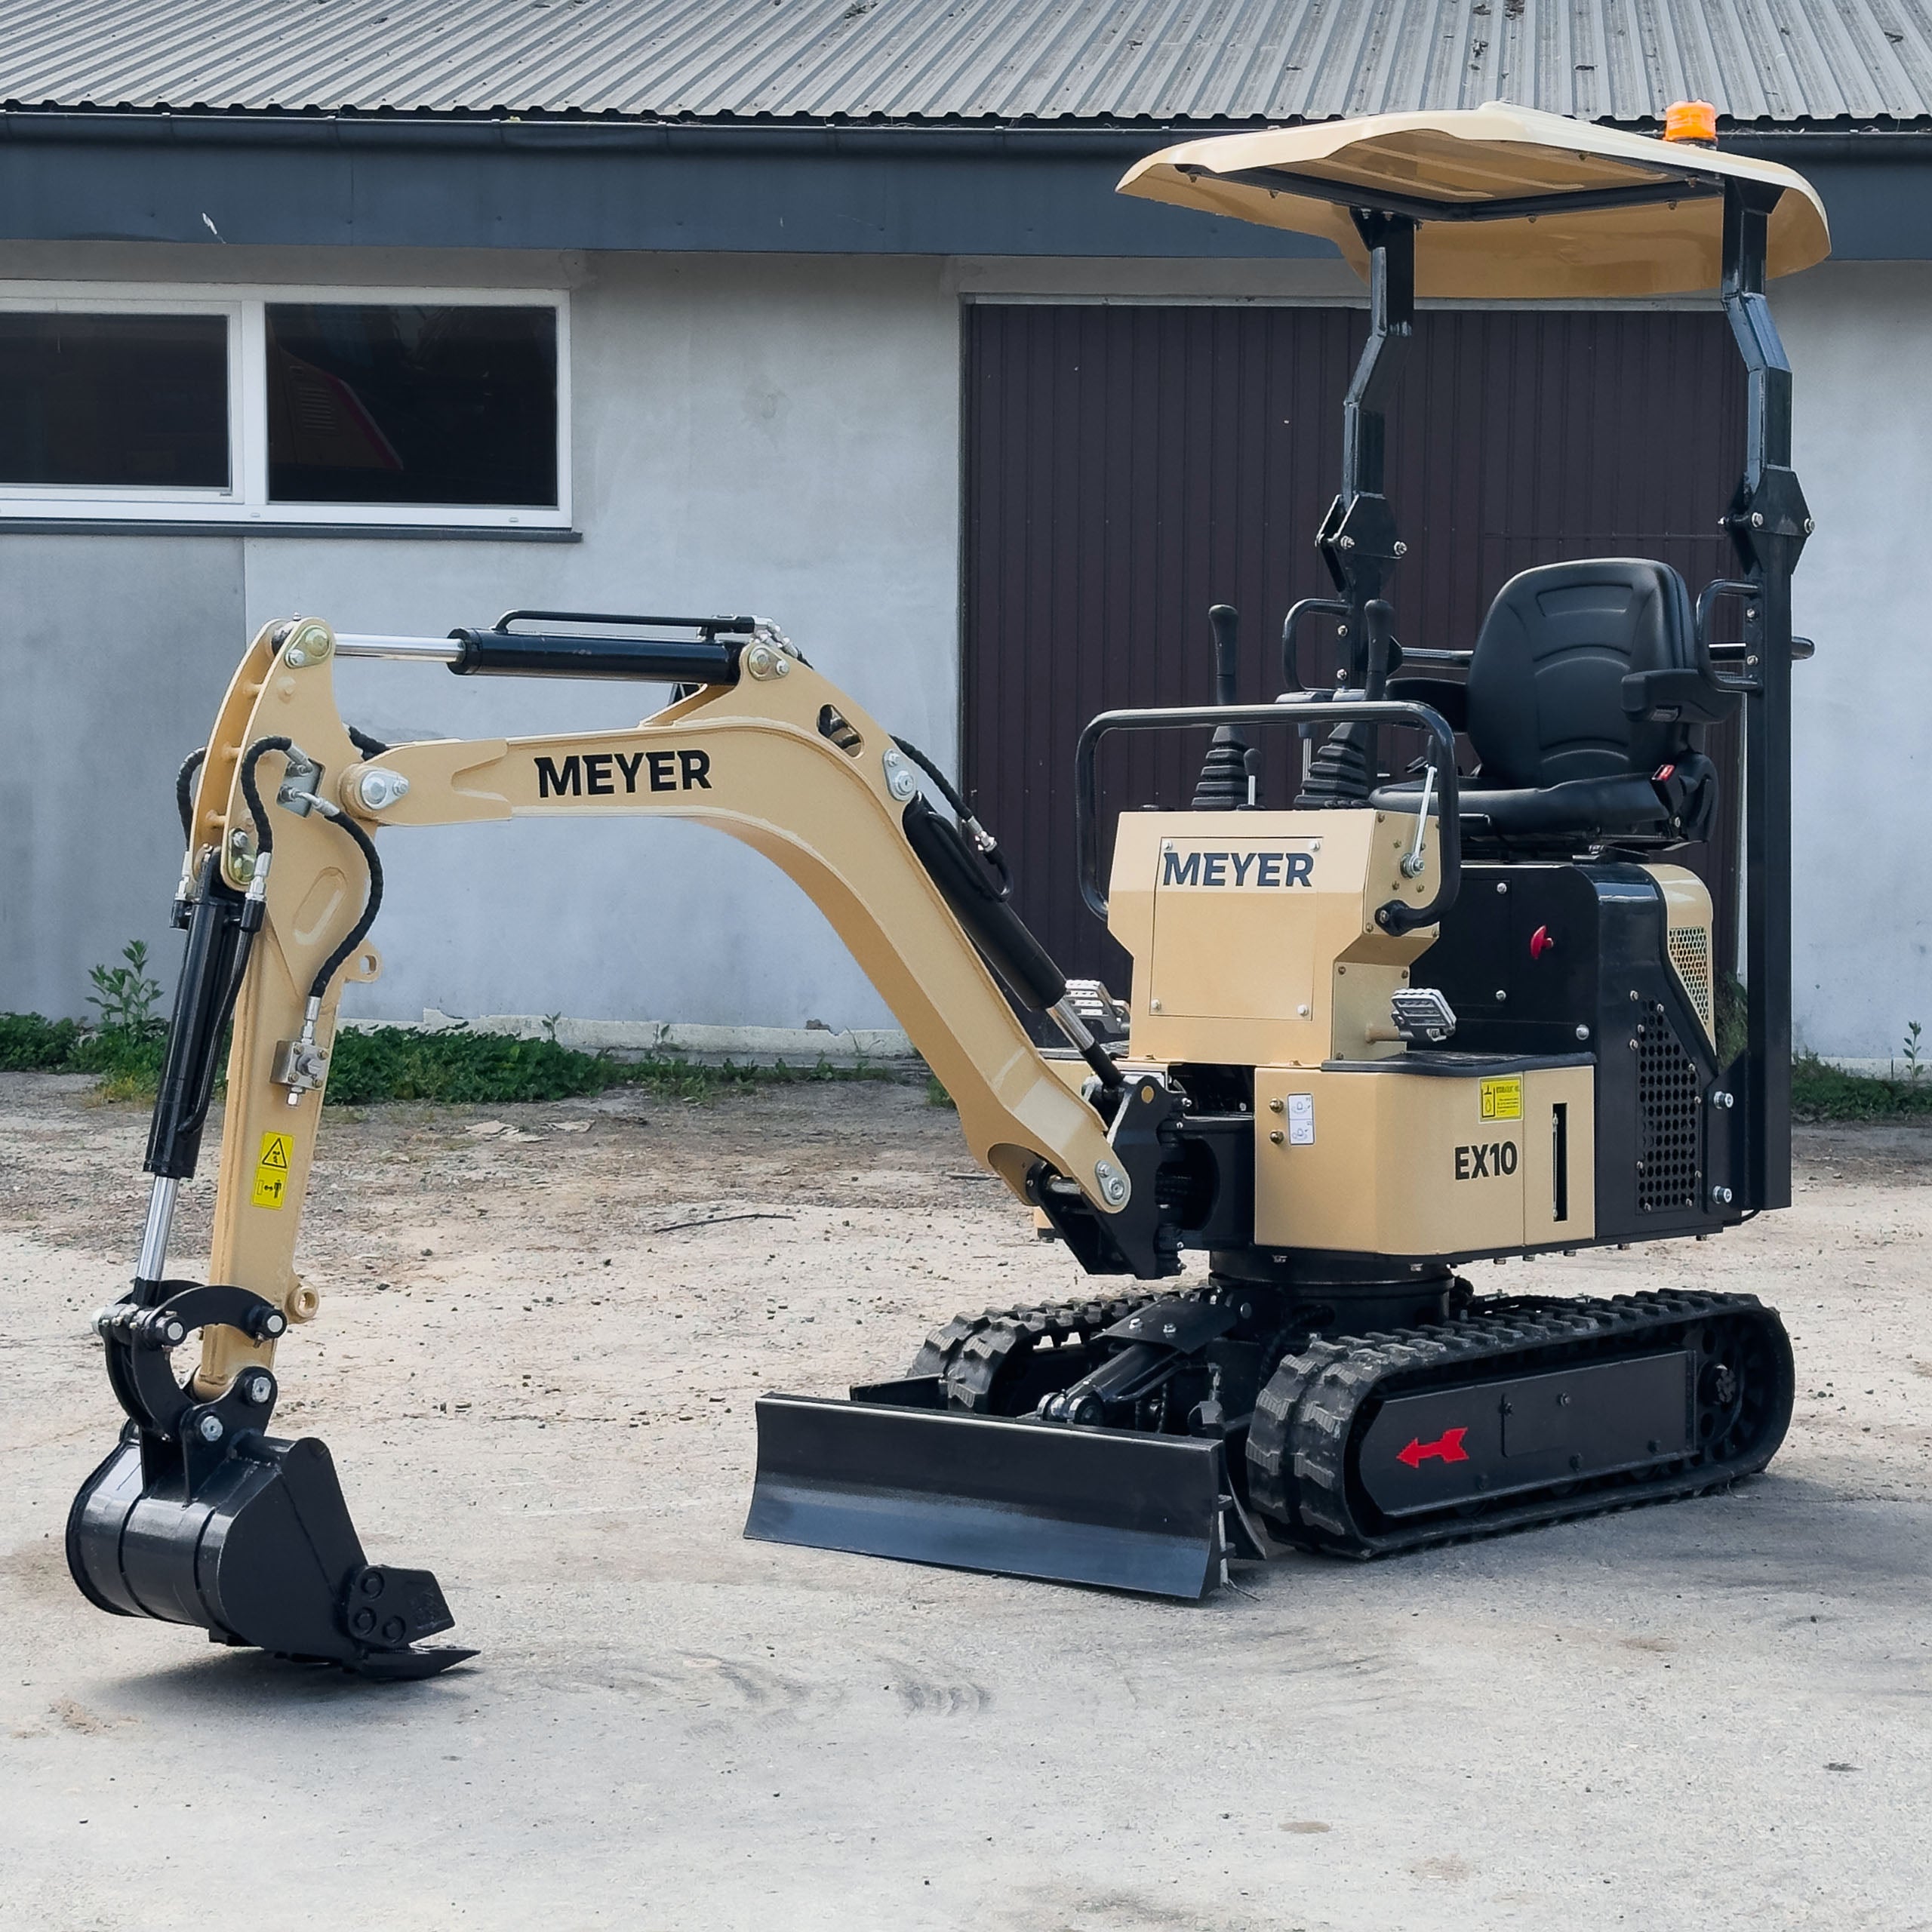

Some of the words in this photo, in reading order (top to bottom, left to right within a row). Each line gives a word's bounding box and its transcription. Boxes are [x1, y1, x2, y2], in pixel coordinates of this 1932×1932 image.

[534, 749, 712, 798] MEYER
[1163, 853, 1314, 887] MEYER
[1455, 1141, 1518, 1180] EX10
